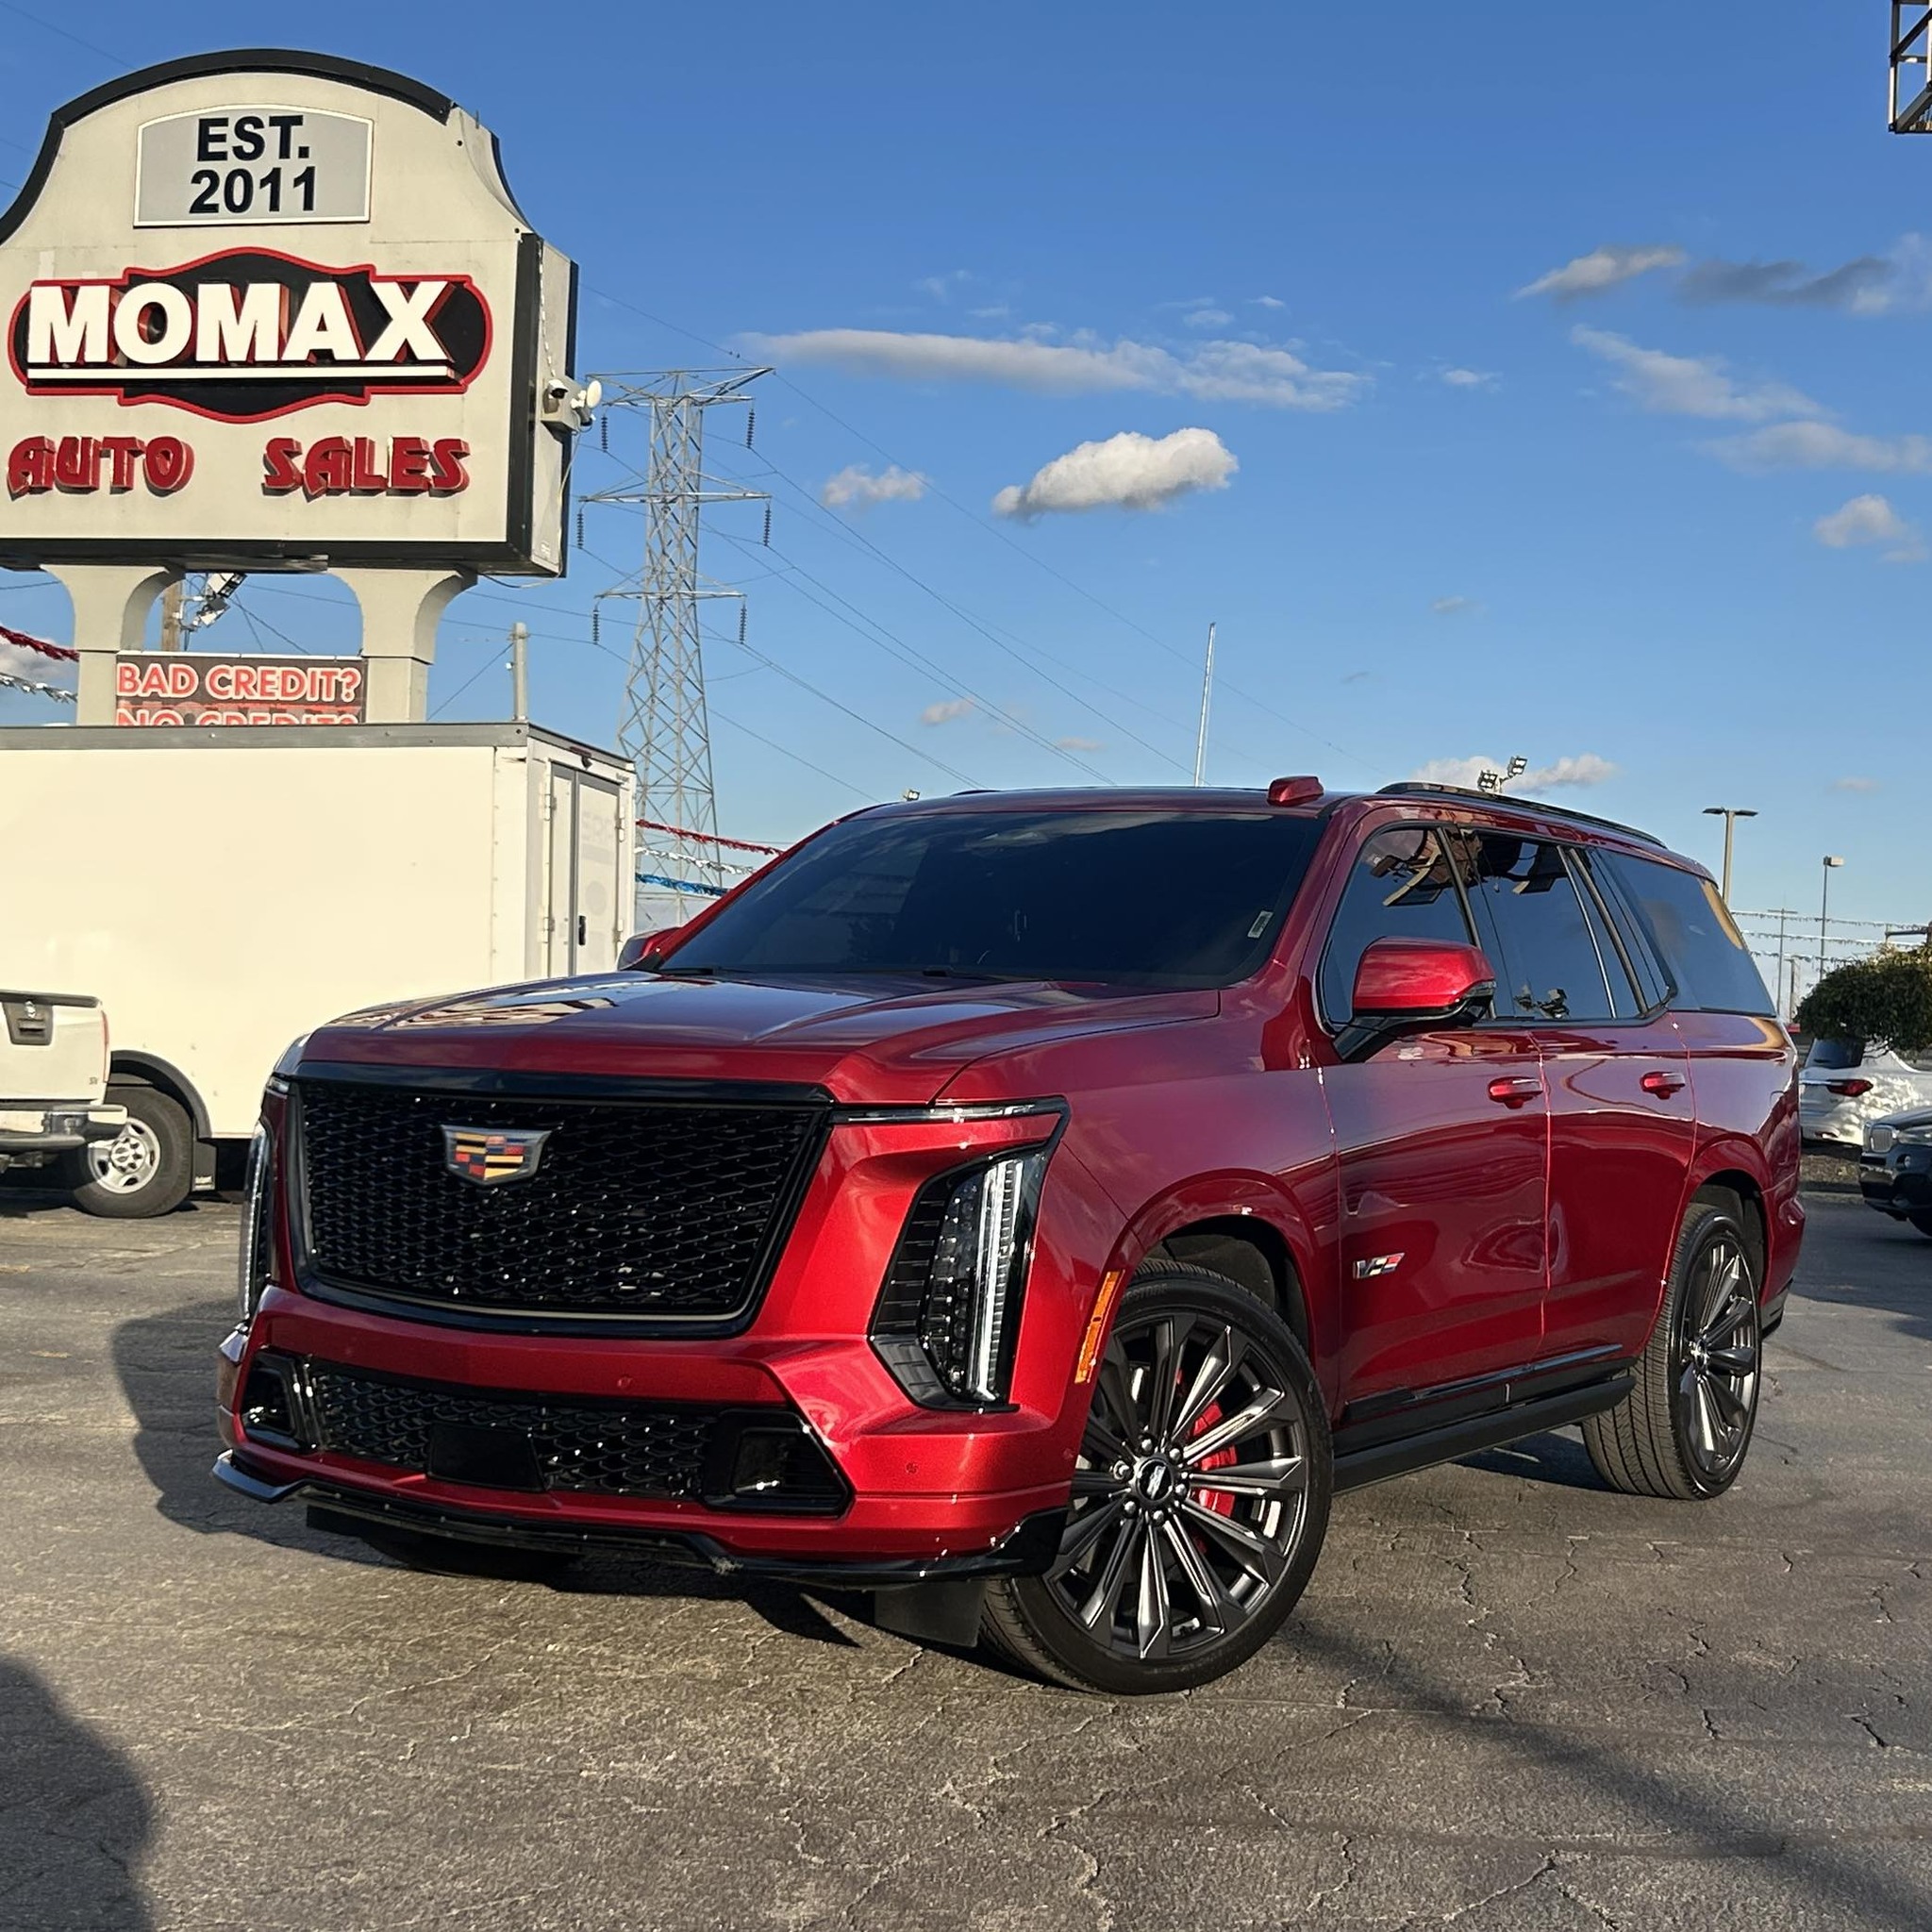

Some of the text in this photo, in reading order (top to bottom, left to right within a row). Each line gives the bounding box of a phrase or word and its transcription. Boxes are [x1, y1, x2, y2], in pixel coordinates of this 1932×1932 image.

[197, 115, 309, 161] EST.
[189, 166, 315, 213] 2011
[27, 280, 451, 365] MOMAX
[8, 436, 470, 499] AUTO SALES
[116, 663, 361, 702] BAD CREDIT?
